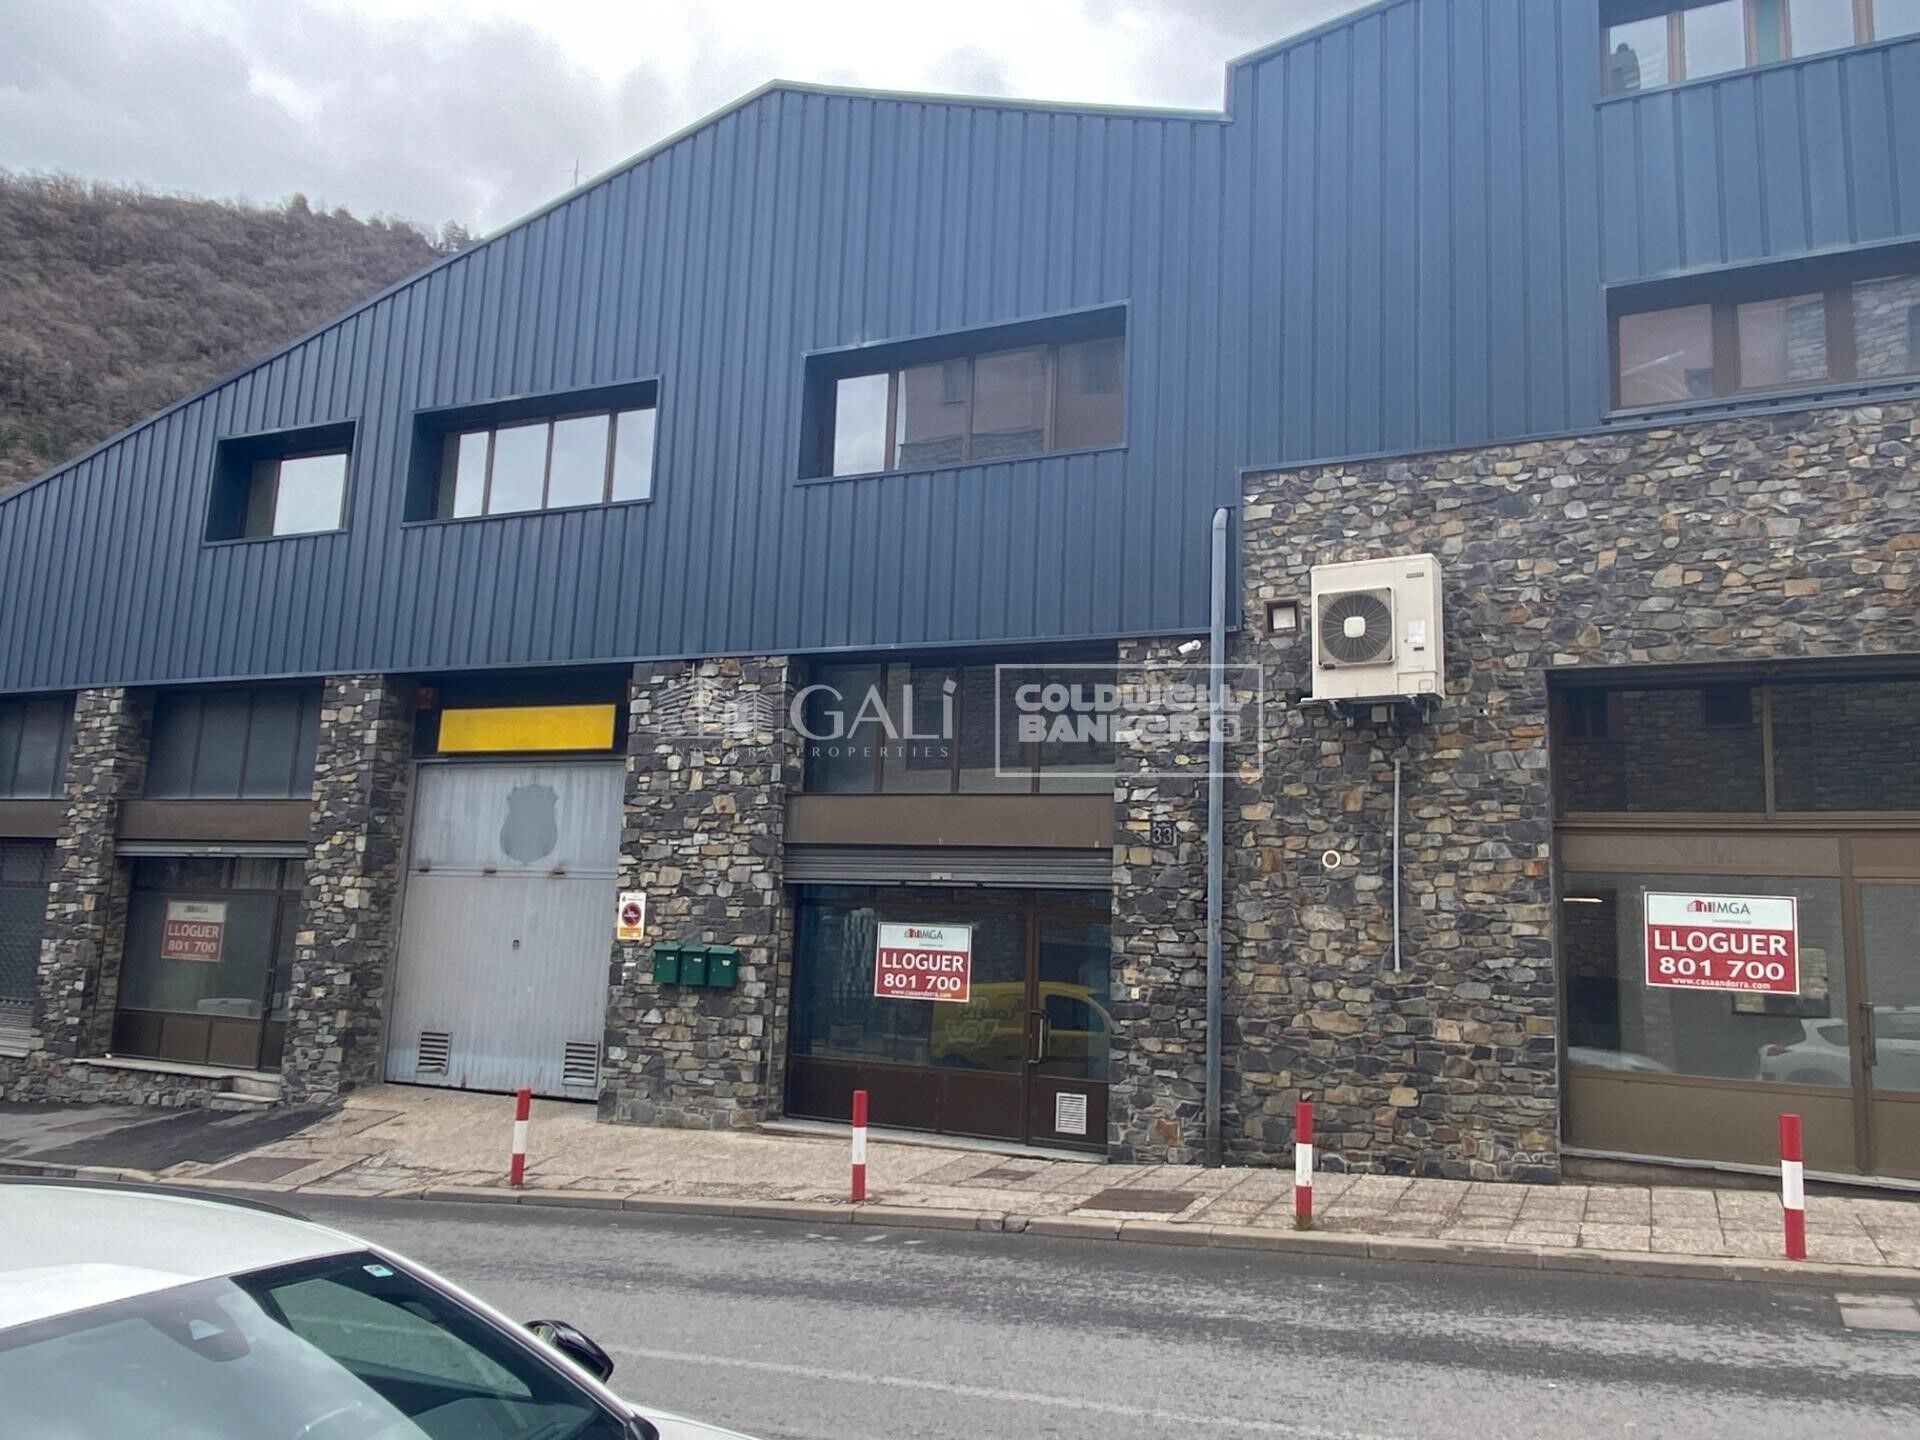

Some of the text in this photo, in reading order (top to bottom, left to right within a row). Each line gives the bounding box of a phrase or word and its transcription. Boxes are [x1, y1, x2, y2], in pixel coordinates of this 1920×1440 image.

[1152, 827, 1172, 844] 33
[168, 924, 219, 939] LLOGUER
[168, 940, 216, 953] 801 700
[1654, 929, 1788, 957] LLOGUER
[882, 952, 964, 973] LLOGUER
[1659, 957, 1785, 980] 801 700
[884, 973, 961, 991] 801 700
[1672, 977, 1771, 989] www.casaandorra.com
